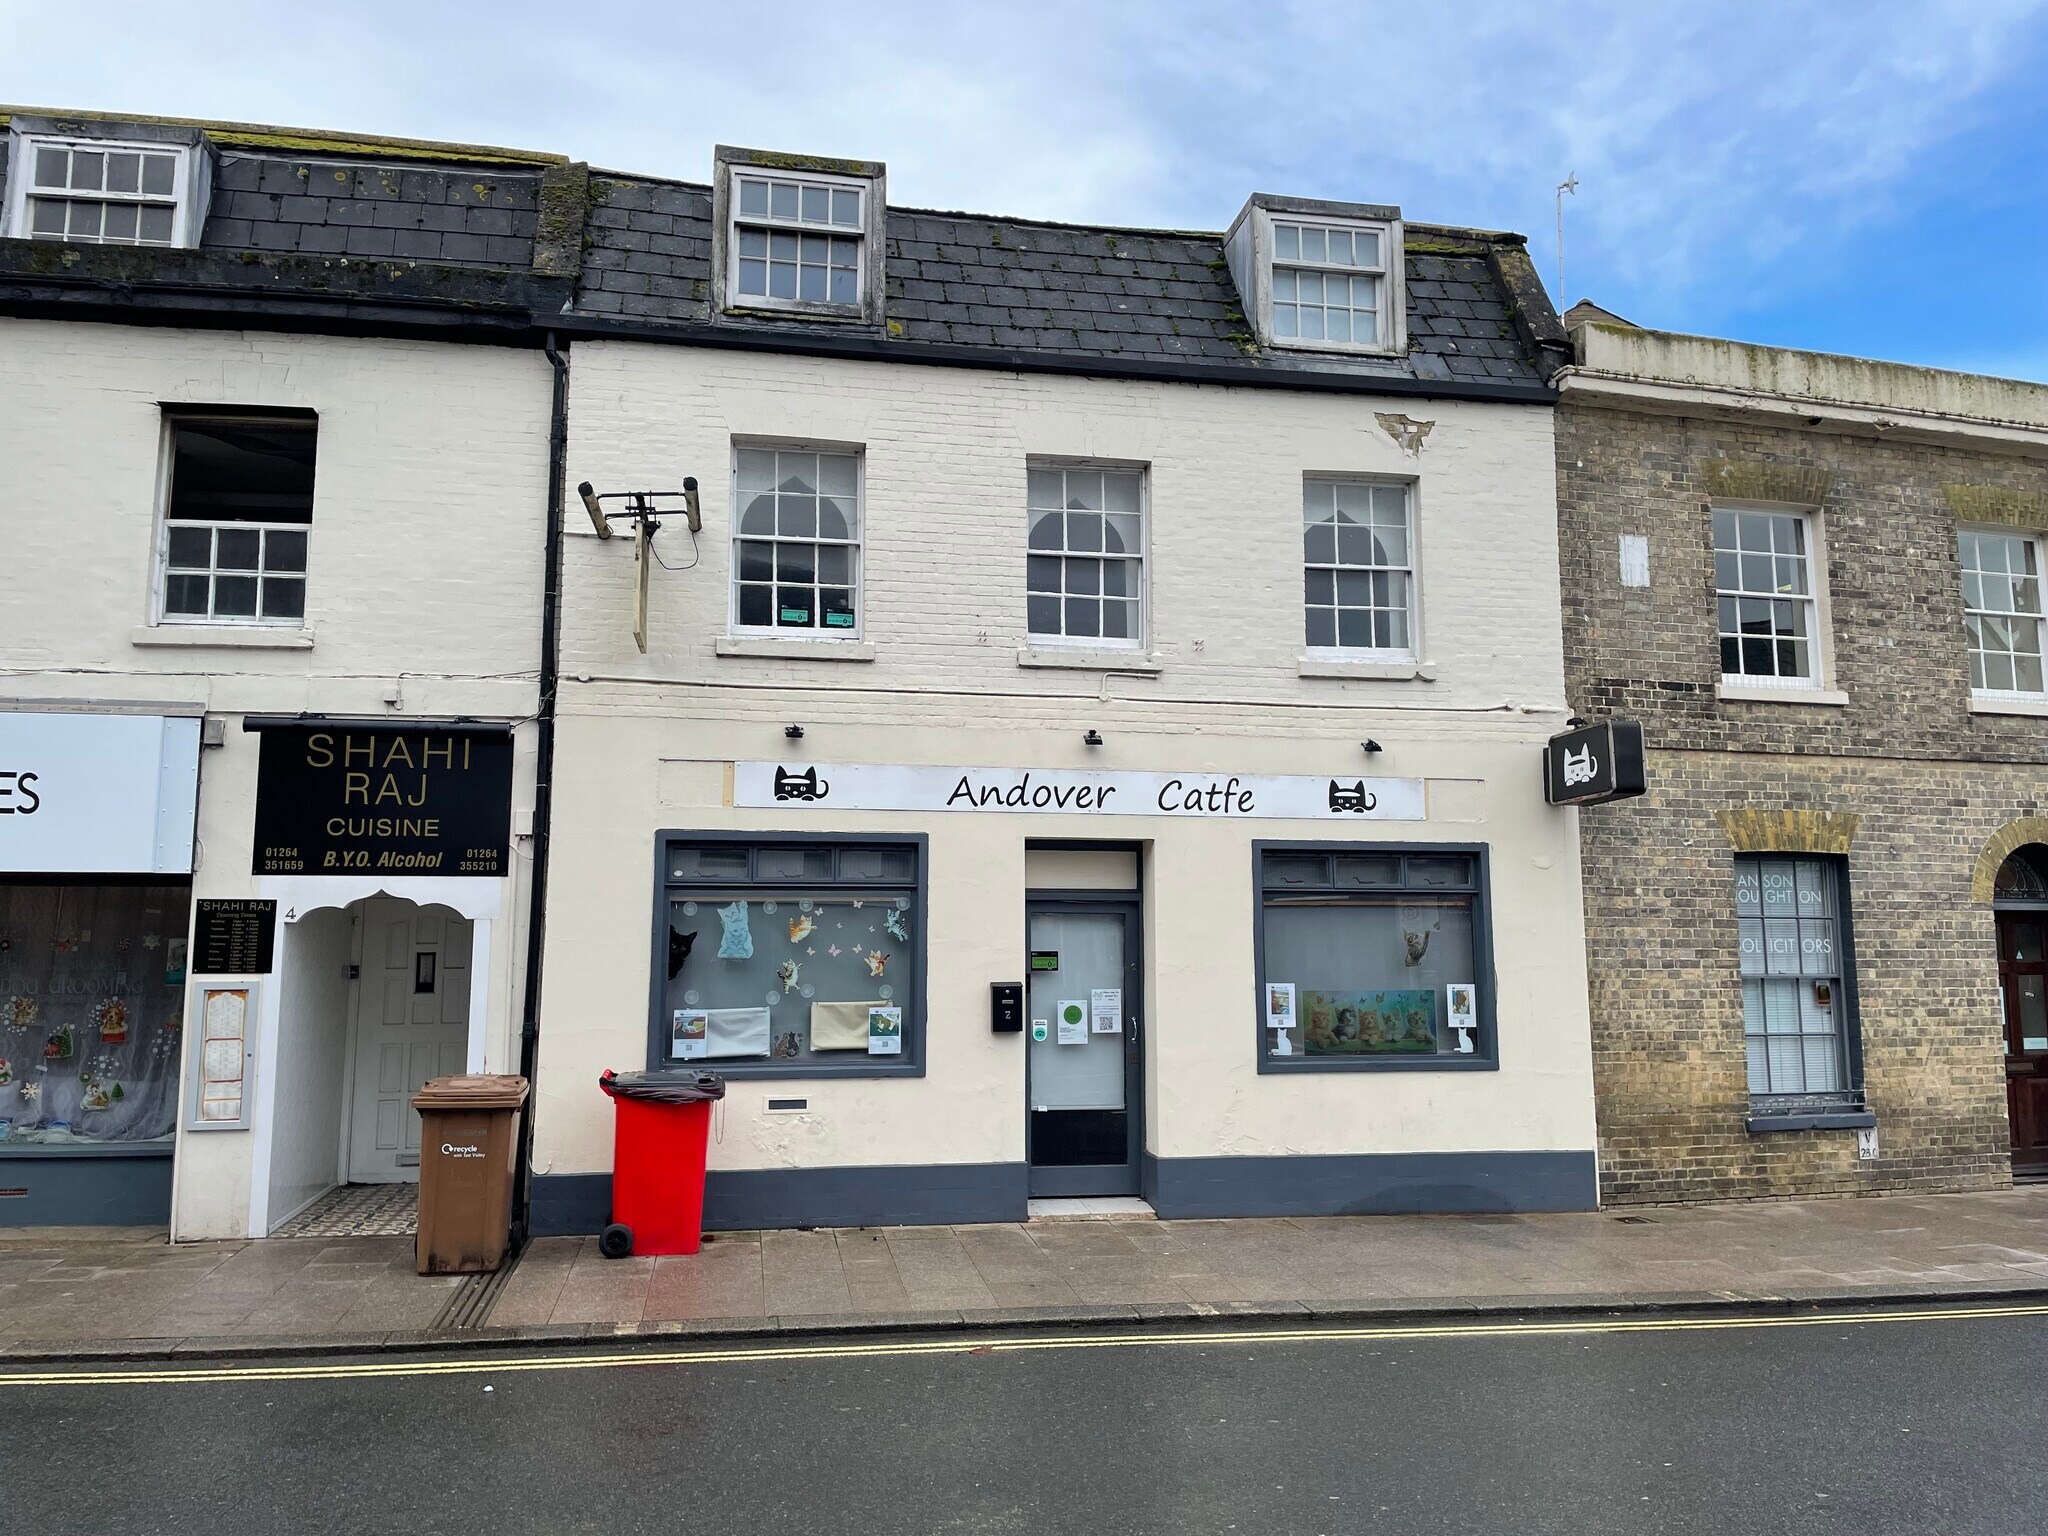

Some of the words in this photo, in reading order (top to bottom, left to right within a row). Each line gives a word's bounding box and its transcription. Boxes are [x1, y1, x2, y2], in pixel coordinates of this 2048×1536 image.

[306, 733, 471, 770] SHAHI
[344, 772, 428, 807] RAJ
[946, 772, 1116, 809] Andover
[1157, 777, 1255, 814] Catfe
[326, 817, 440, 837] CUISINE
[265, 847, 298, 857] 01264
[323, 850, 372, 867] B.Y.O.
[377, 851, 443, 868] Alcohol
[466, 848, 498, 859] 01264
[264, 860, 304, 870] 351659
[459, 861, 498, 871] 355210
[1737, 874, 1793, 888] ANSON
[1736, 889, 1822, 904] OUGHTON
[202, 901, 244, 911] SHAHI
[249, 901, 272, 911] RAJ
[285, 906, 297, 919] 4
[1739, 938, 1832, 954] OLICITORS
[48, 976, 144, 995] GROOMING
[1004, 1010, 1011, 1019] 2
[453, 1145, 478, 1153] recycle
